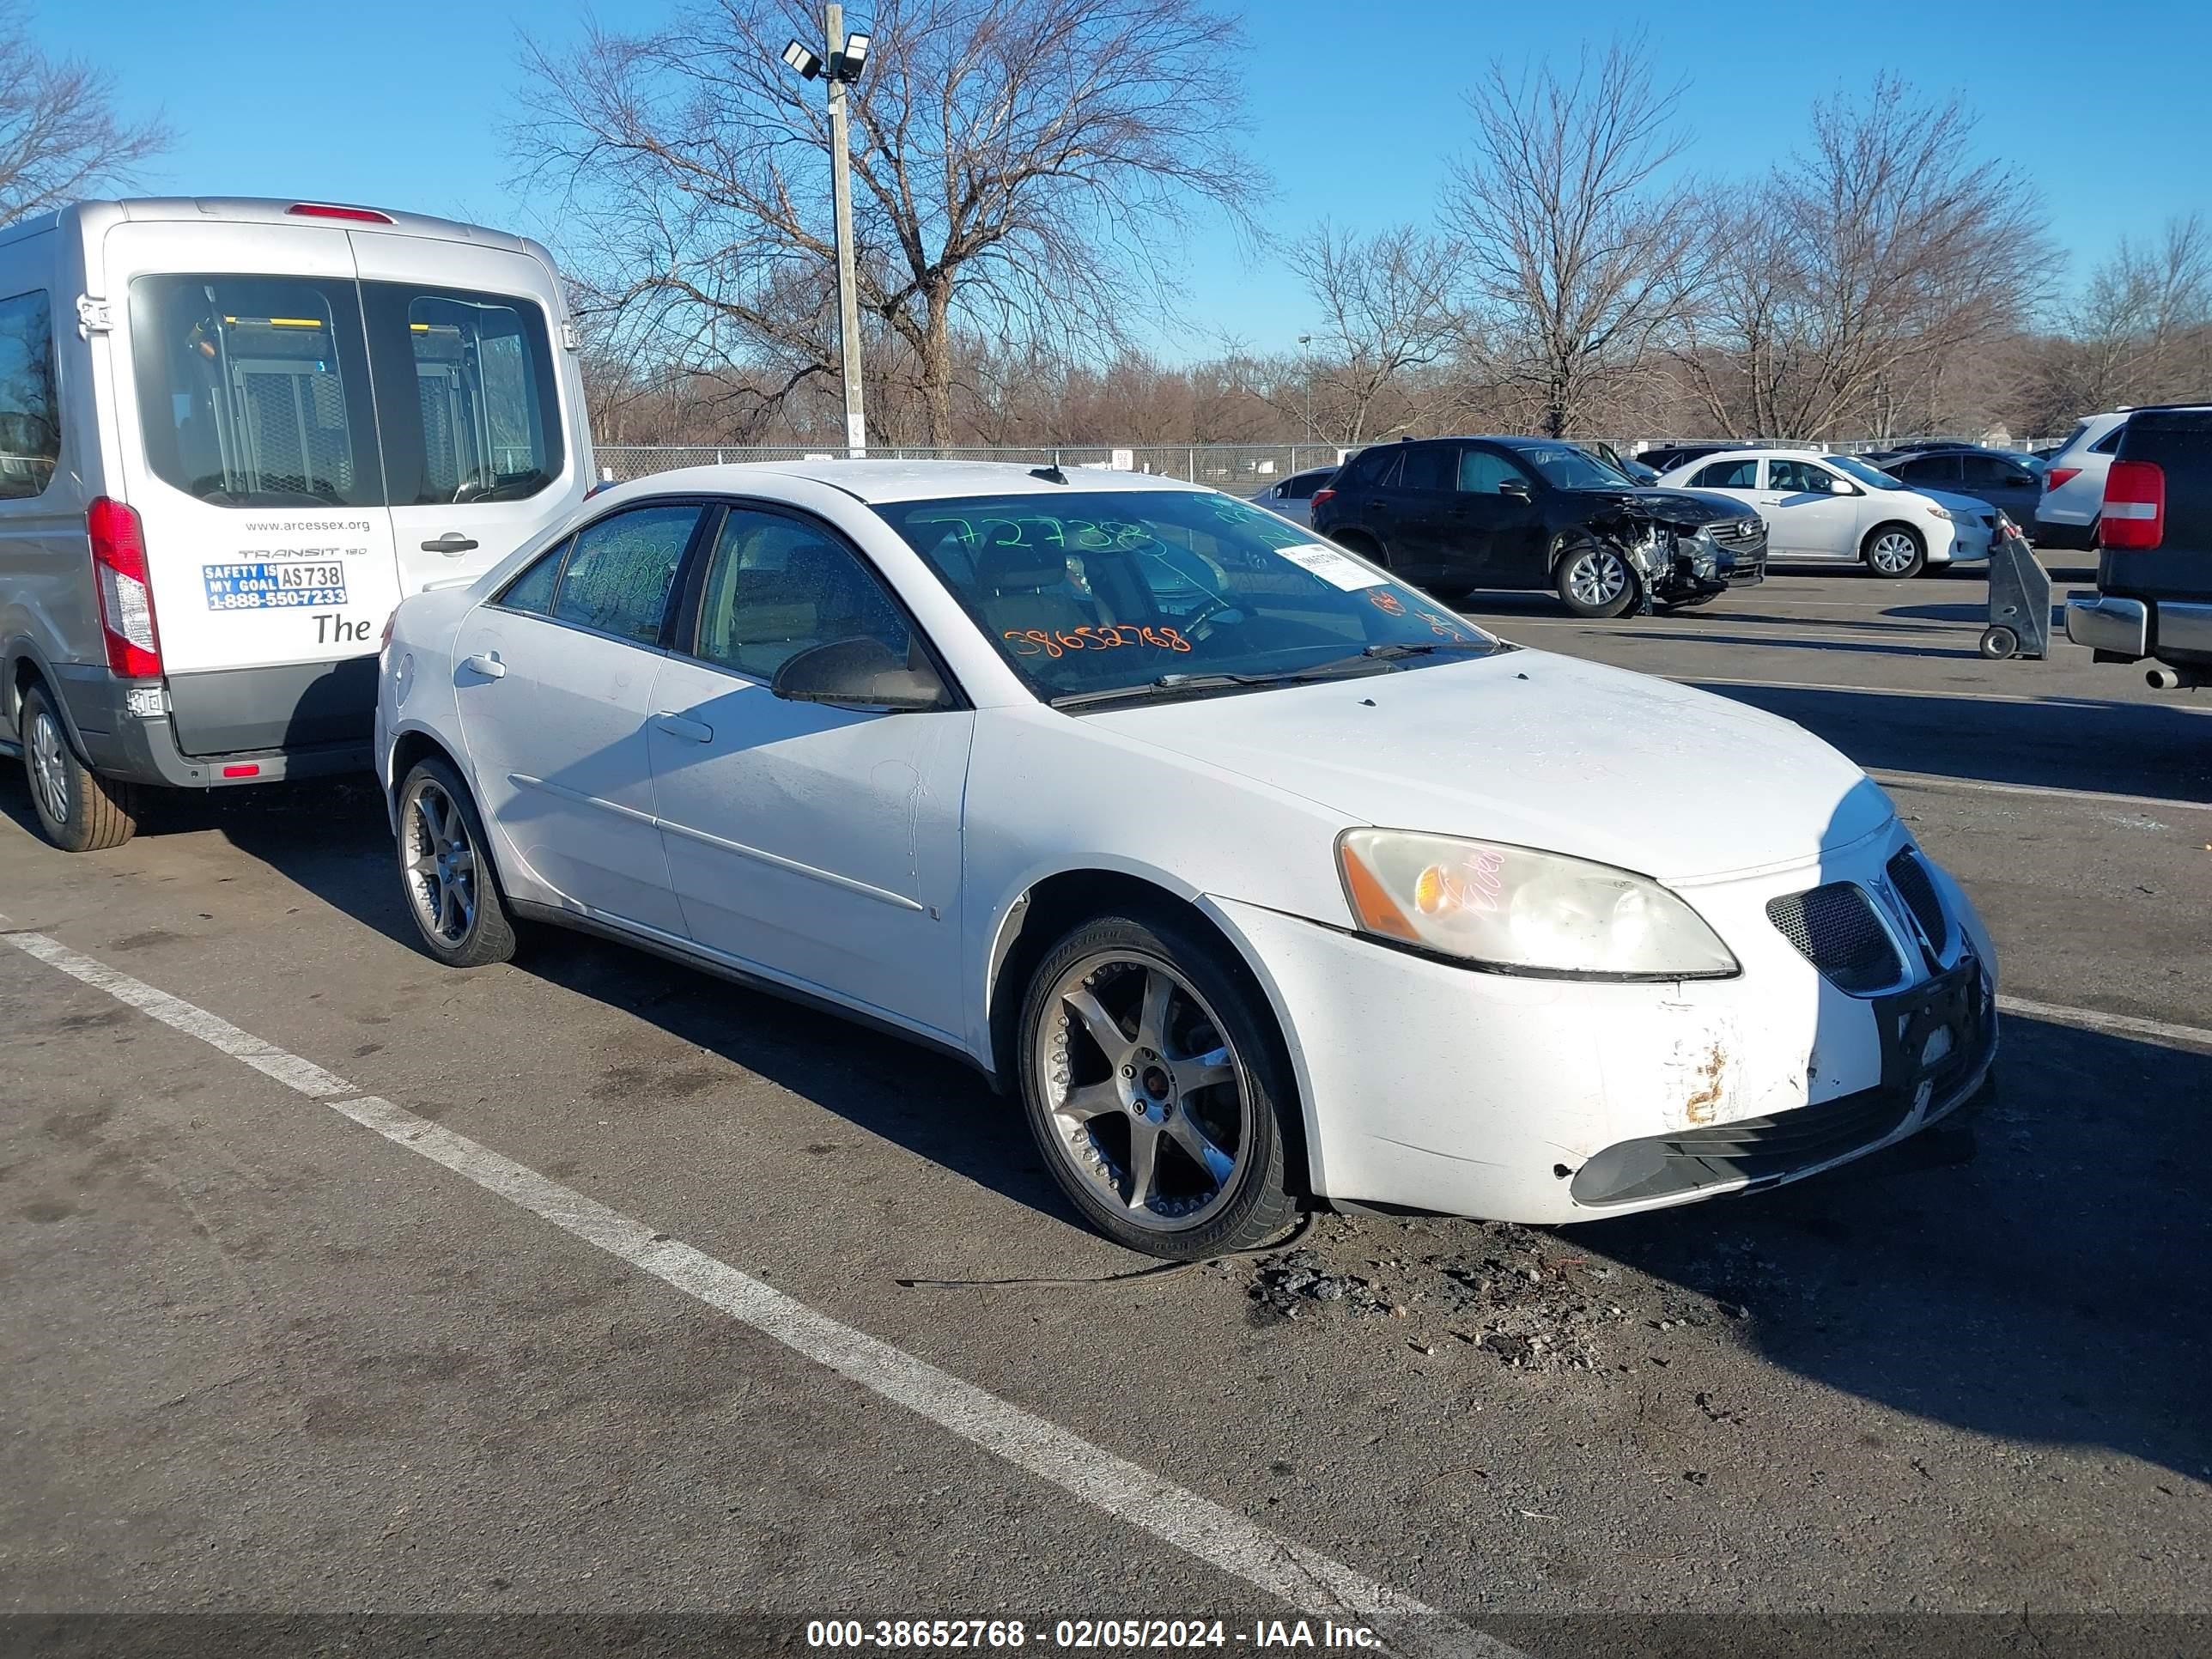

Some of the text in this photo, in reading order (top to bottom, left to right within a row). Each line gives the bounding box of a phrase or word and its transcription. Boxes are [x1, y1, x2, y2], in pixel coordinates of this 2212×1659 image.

[246, 520, 371, 532] www.arcessex.org
[931, 518, 1169, 557] 72738
[238, 548, 341, 559] TRANSIT
[204, 564, 277, 580] SAFETY IS
[282, 566, 341, 587] AS738
[210, 579, 277, 592] MY GOAL
[210, 589, 347, 610] 1-888-550-7233
[312, 613, 371, 644] The
[1004, 625, 1192, 658] 38652768
